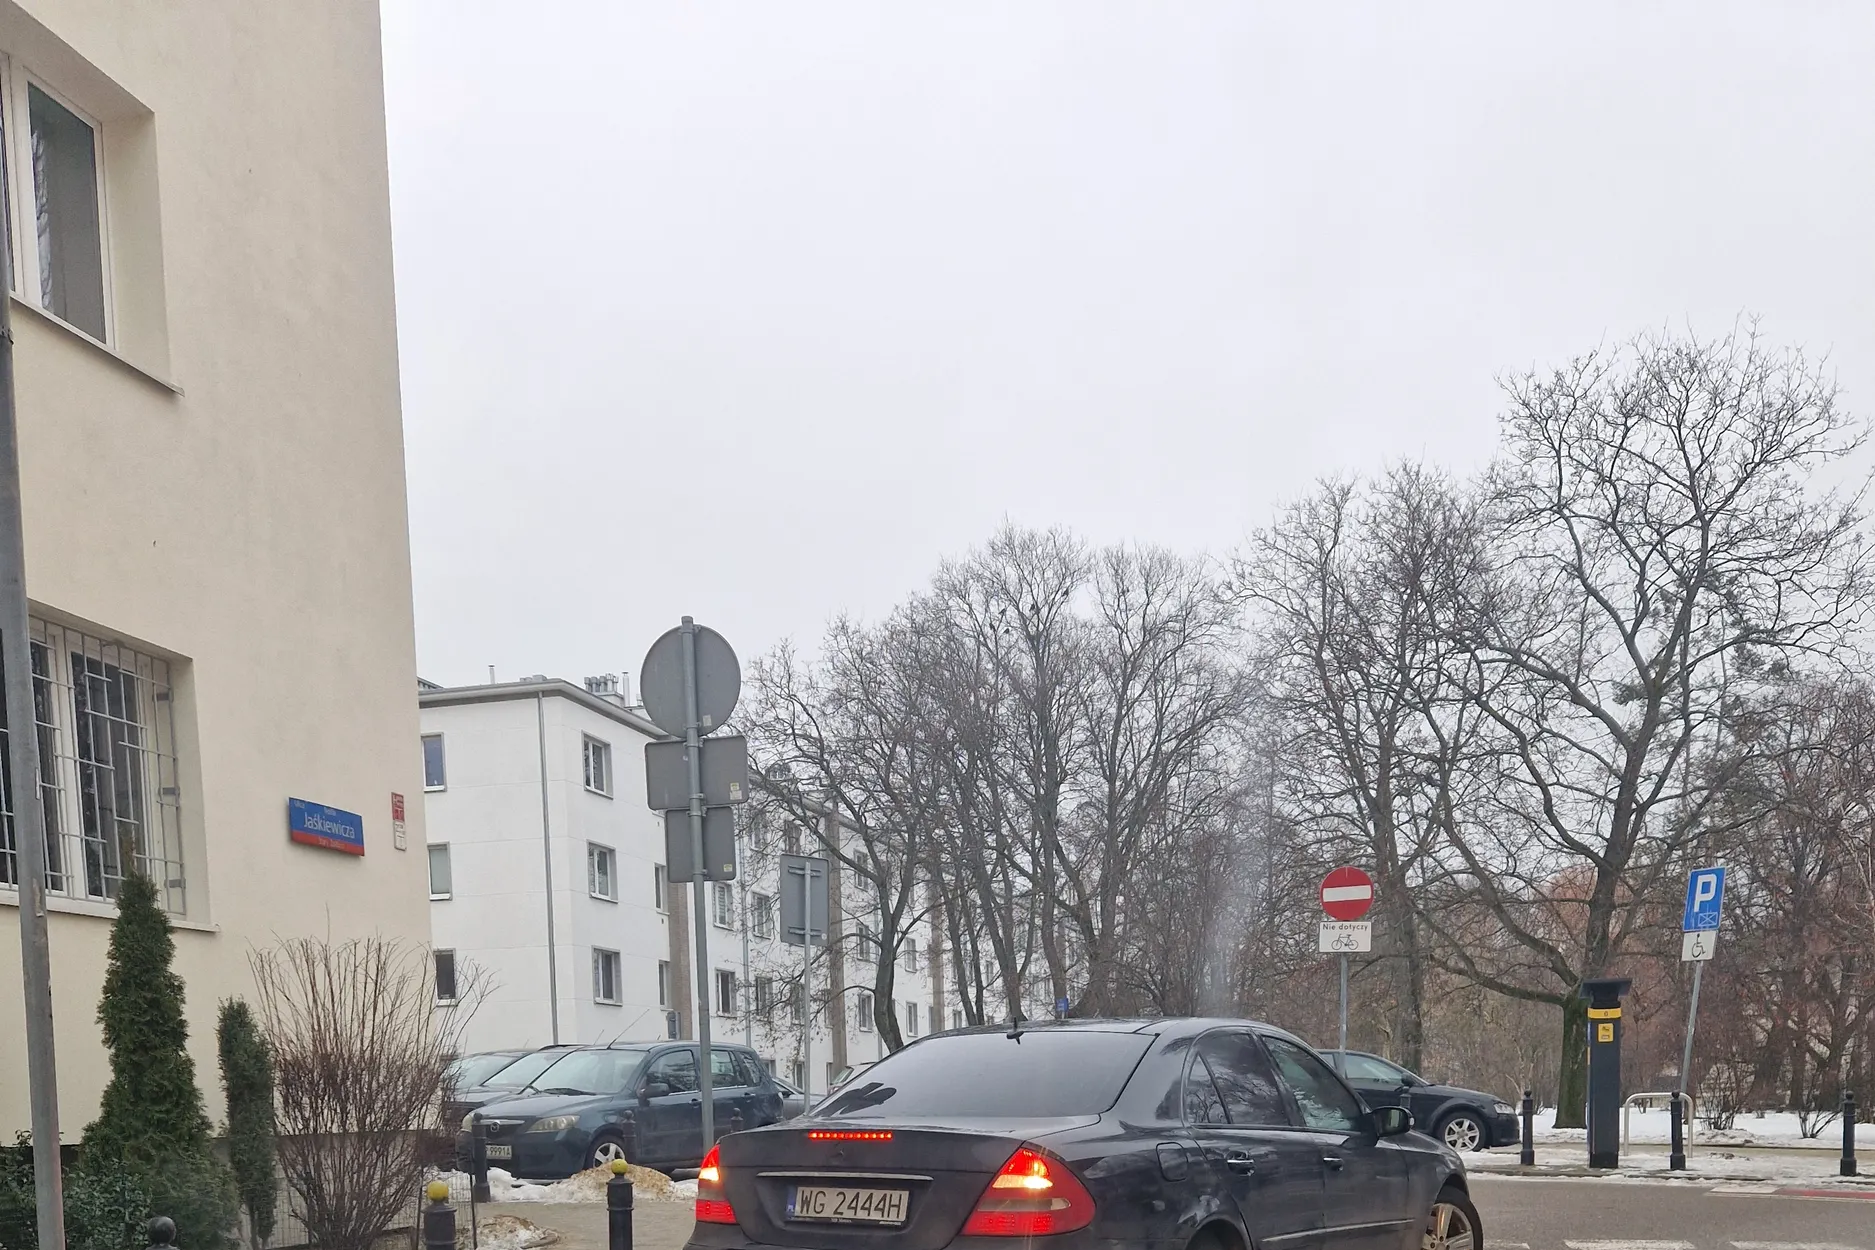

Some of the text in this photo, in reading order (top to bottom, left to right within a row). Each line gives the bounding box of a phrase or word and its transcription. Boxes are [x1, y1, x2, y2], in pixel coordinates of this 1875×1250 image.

[303, 811, 356, 839] Jaśkiewicza
[1693, 873, 1717, 912] P
[1322, 923, 1369, 931] Nie dotyczy
[800, 1189, 902, 1219] WG 2444H
